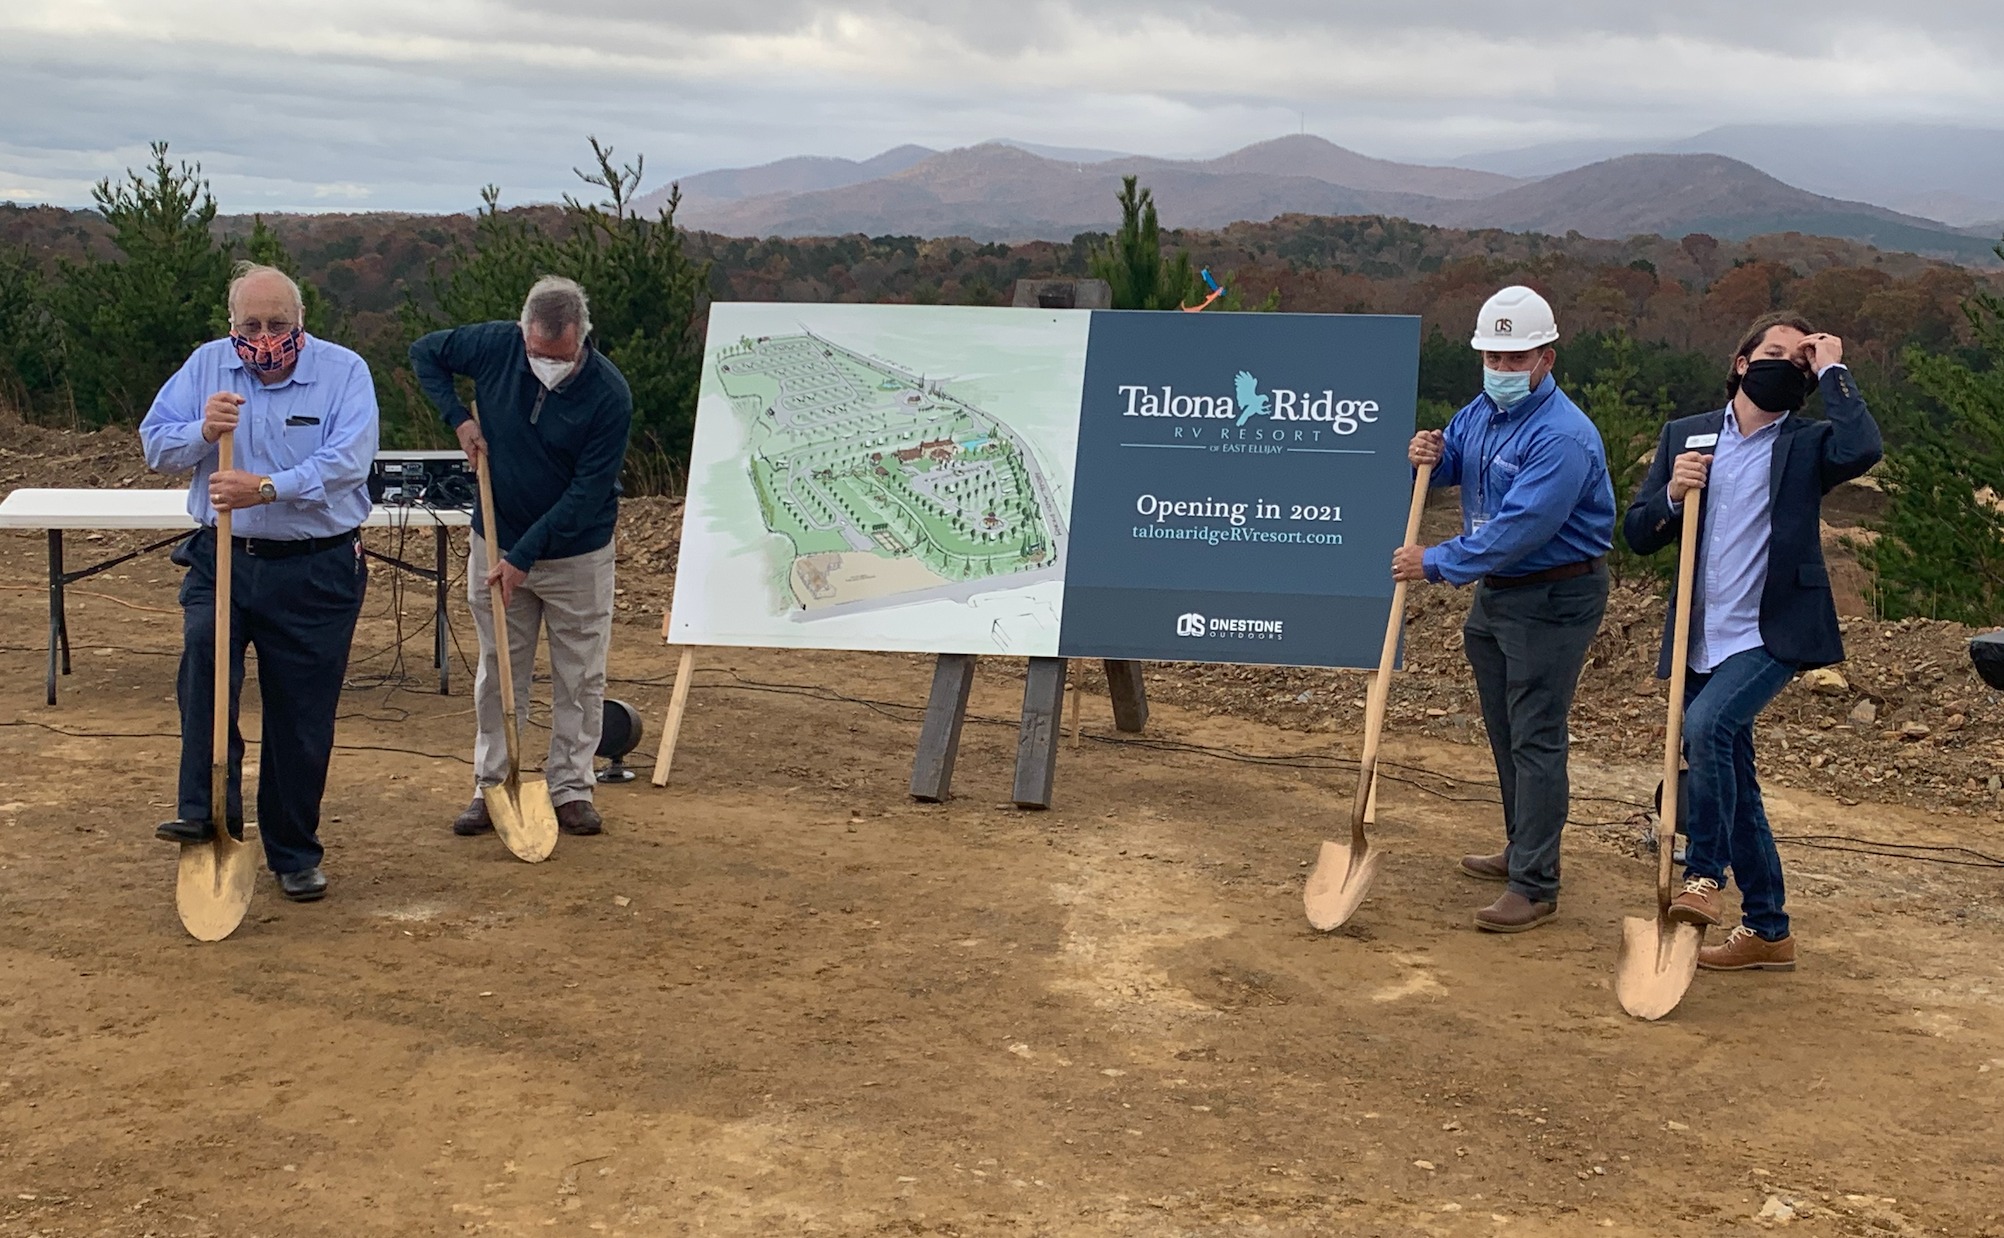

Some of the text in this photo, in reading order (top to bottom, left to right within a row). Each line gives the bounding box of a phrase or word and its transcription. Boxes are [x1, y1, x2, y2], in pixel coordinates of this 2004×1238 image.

[1118, 385, 1380, 435] Talona Ridge
[1174, 426, 1322, 442] RV RESORT
[1222, 443, 1245, 453] EAST
[1249, 444, 1283, 455] ELLIJAY
[1136, 494, 1343, 526] Opening in 2021
[1132, 525, 1343, 546] talonaridgeRVresort.com
[1209, 618, 1283, 633] ONESTONE
[1209, 631, 1283, 640] OUTDOORS
